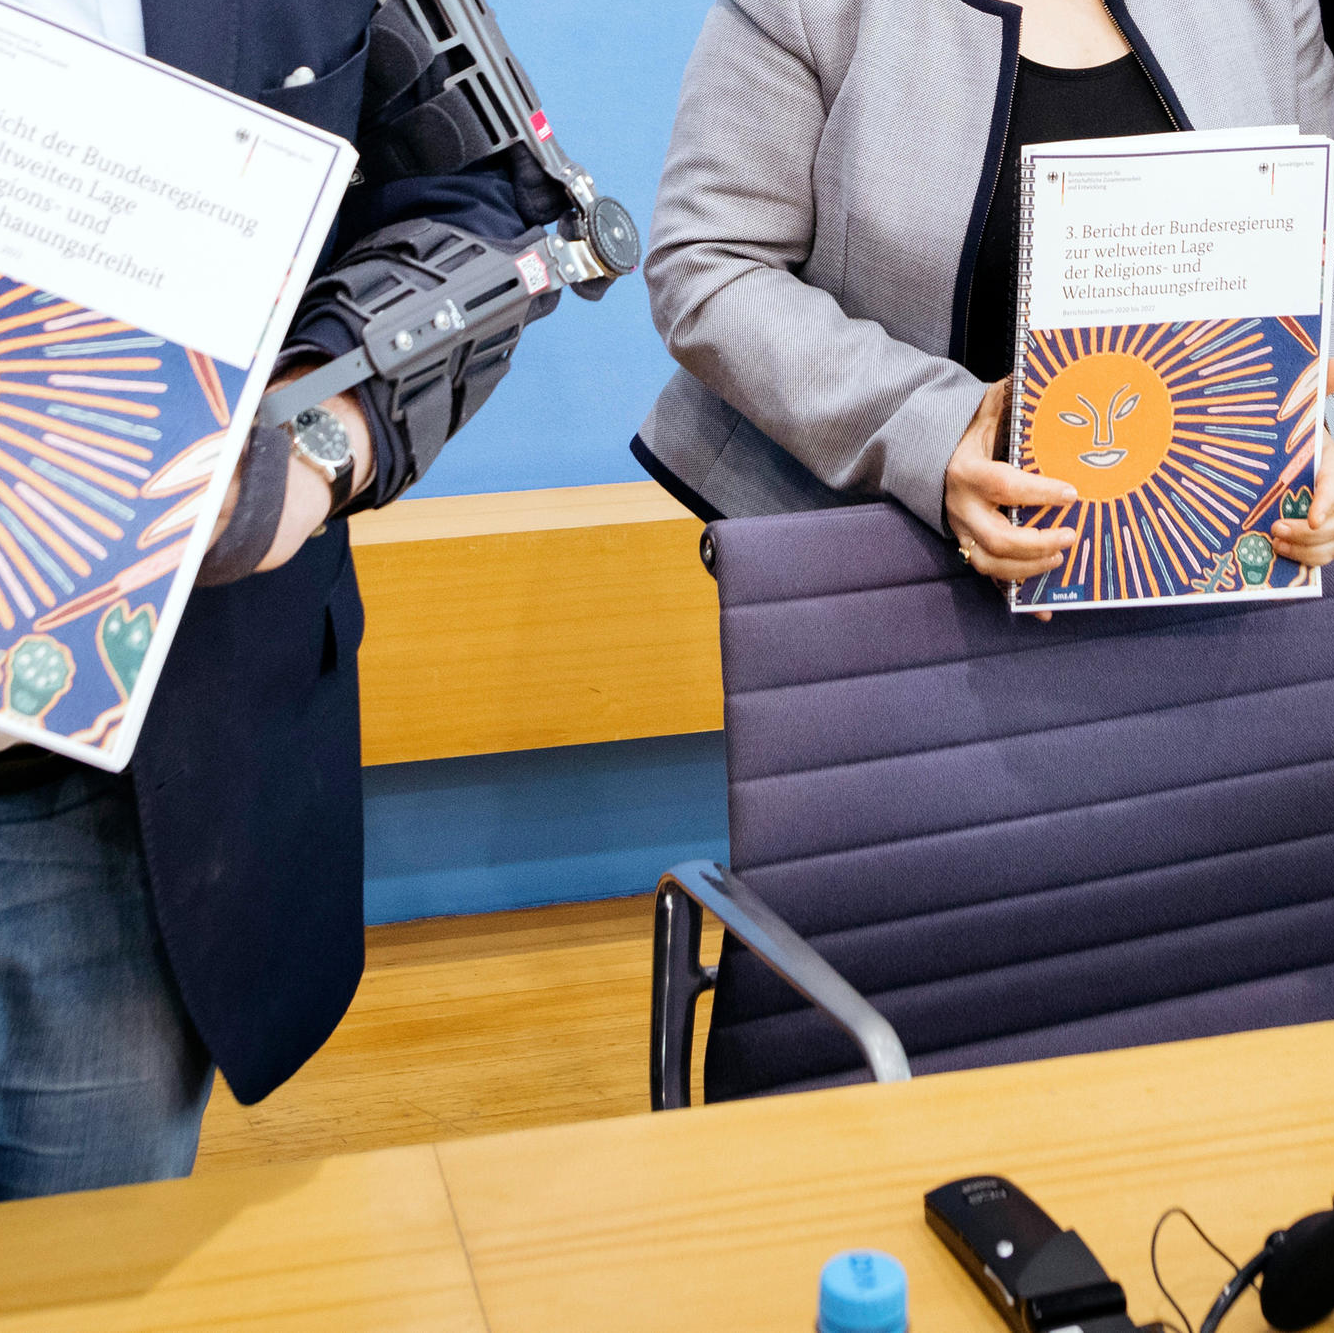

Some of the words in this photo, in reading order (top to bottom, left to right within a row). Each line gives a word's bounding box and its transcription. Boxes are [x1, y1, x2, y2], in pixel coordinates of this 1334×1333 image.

[41, 130, 79, 159] der
[80, 145, 259, 238] Bundesregierung
[87, 179, 139, 215] Lage
[67, 207, 112, 235] und
[1066, 225, 1078, 240] 3.
[1082, 222, 1137, 239] Bericht
[1140, 221, 1166, 236] der
[1170, 216, 1294, 234] Bundesregierung
[1065, 248, 1090, 260] zur
[1094, 242, 1176, 258] weltweiten
[1181, 239, 1214, 256] Lage
[1064, 264, 1090, 280] der
[1094, 261, 1168, 281] Religions-
[1172, 258, 1201, 274] und
[1062, 275, 1248, 300] Weltanschauungsfreiheit
